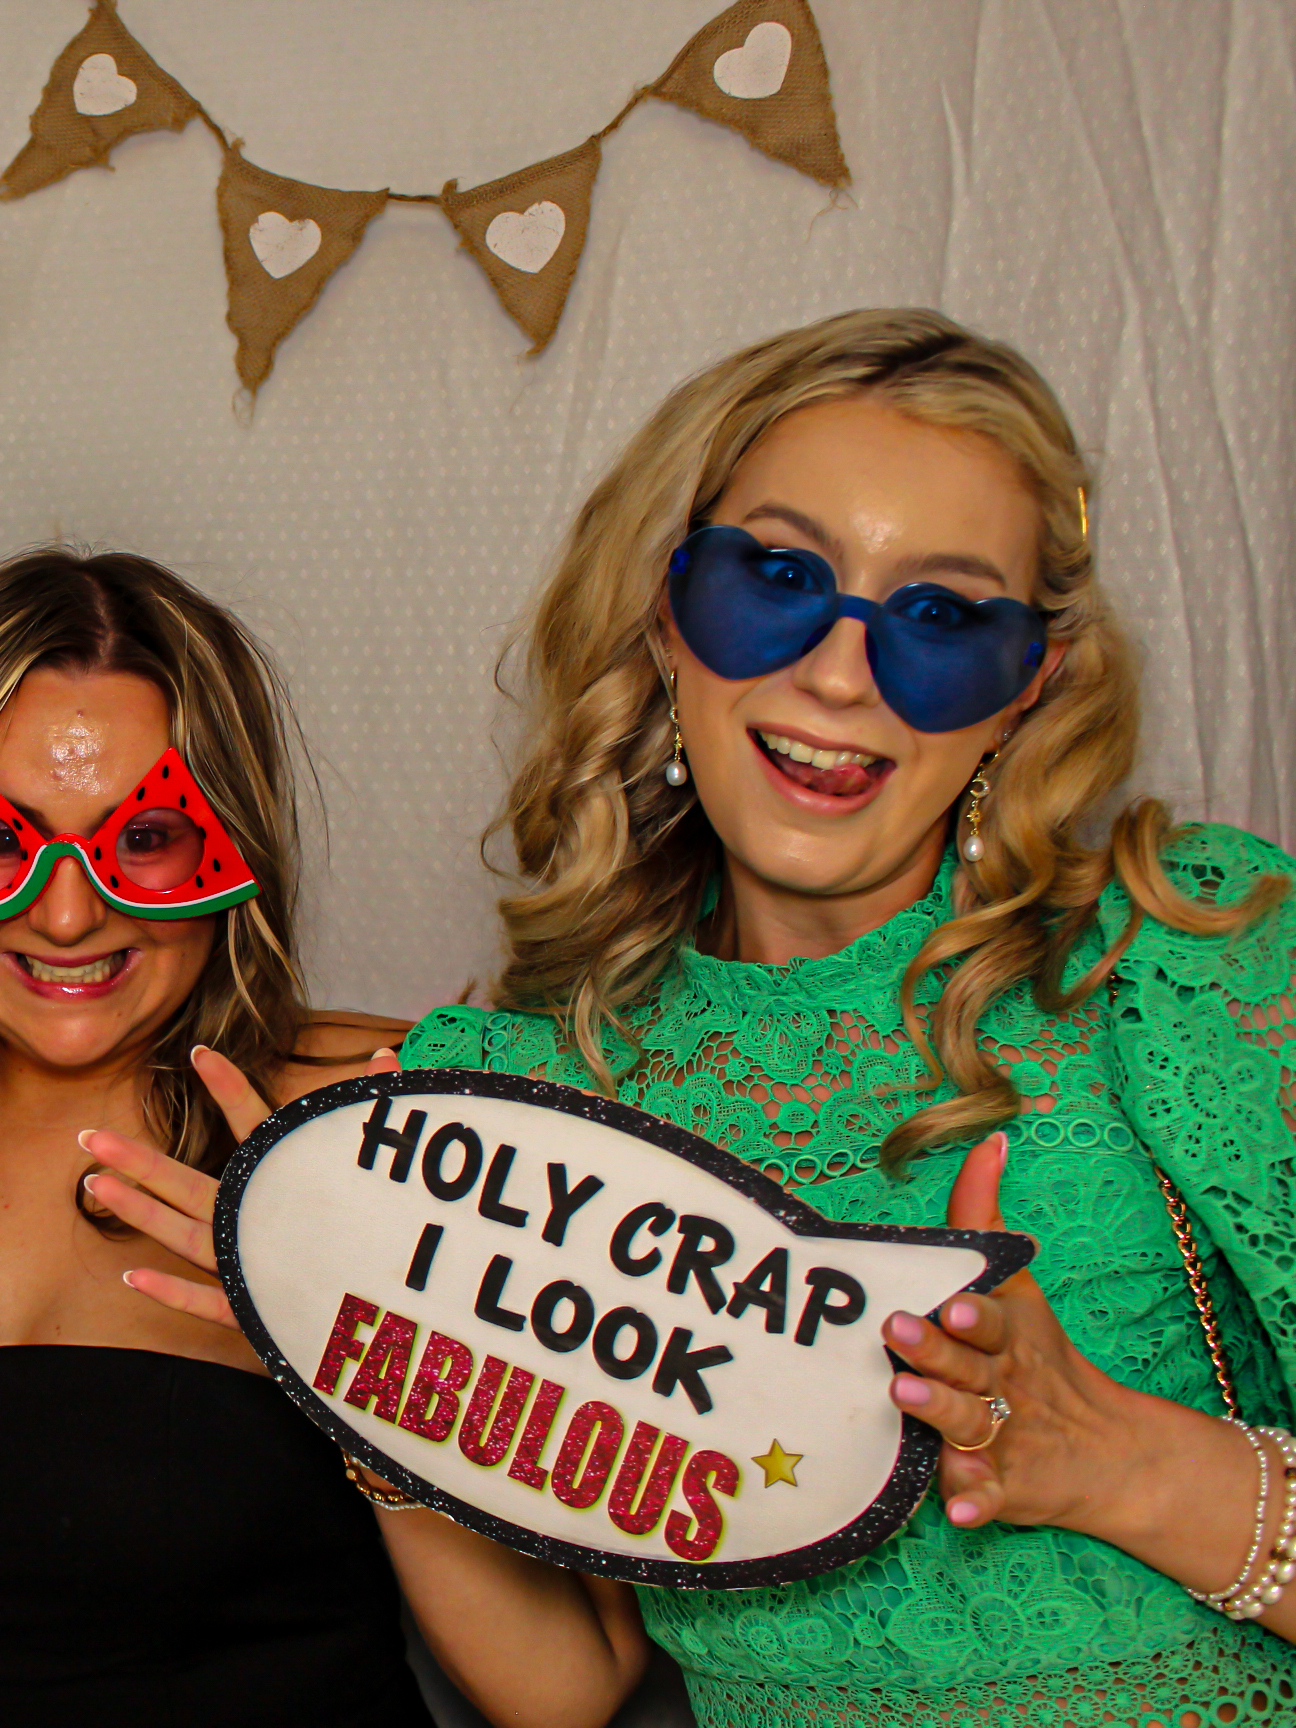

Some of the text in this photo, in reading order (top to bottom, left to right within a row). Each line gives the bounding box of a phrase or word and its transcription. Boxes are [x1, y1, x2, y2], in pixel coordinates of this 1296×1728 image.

[357, 1096, 866, 1346] HOLY CRAP
[406, 1223, 734, 1414] I LOOK
[312, 1292, 740, 1561] FABULOUS
